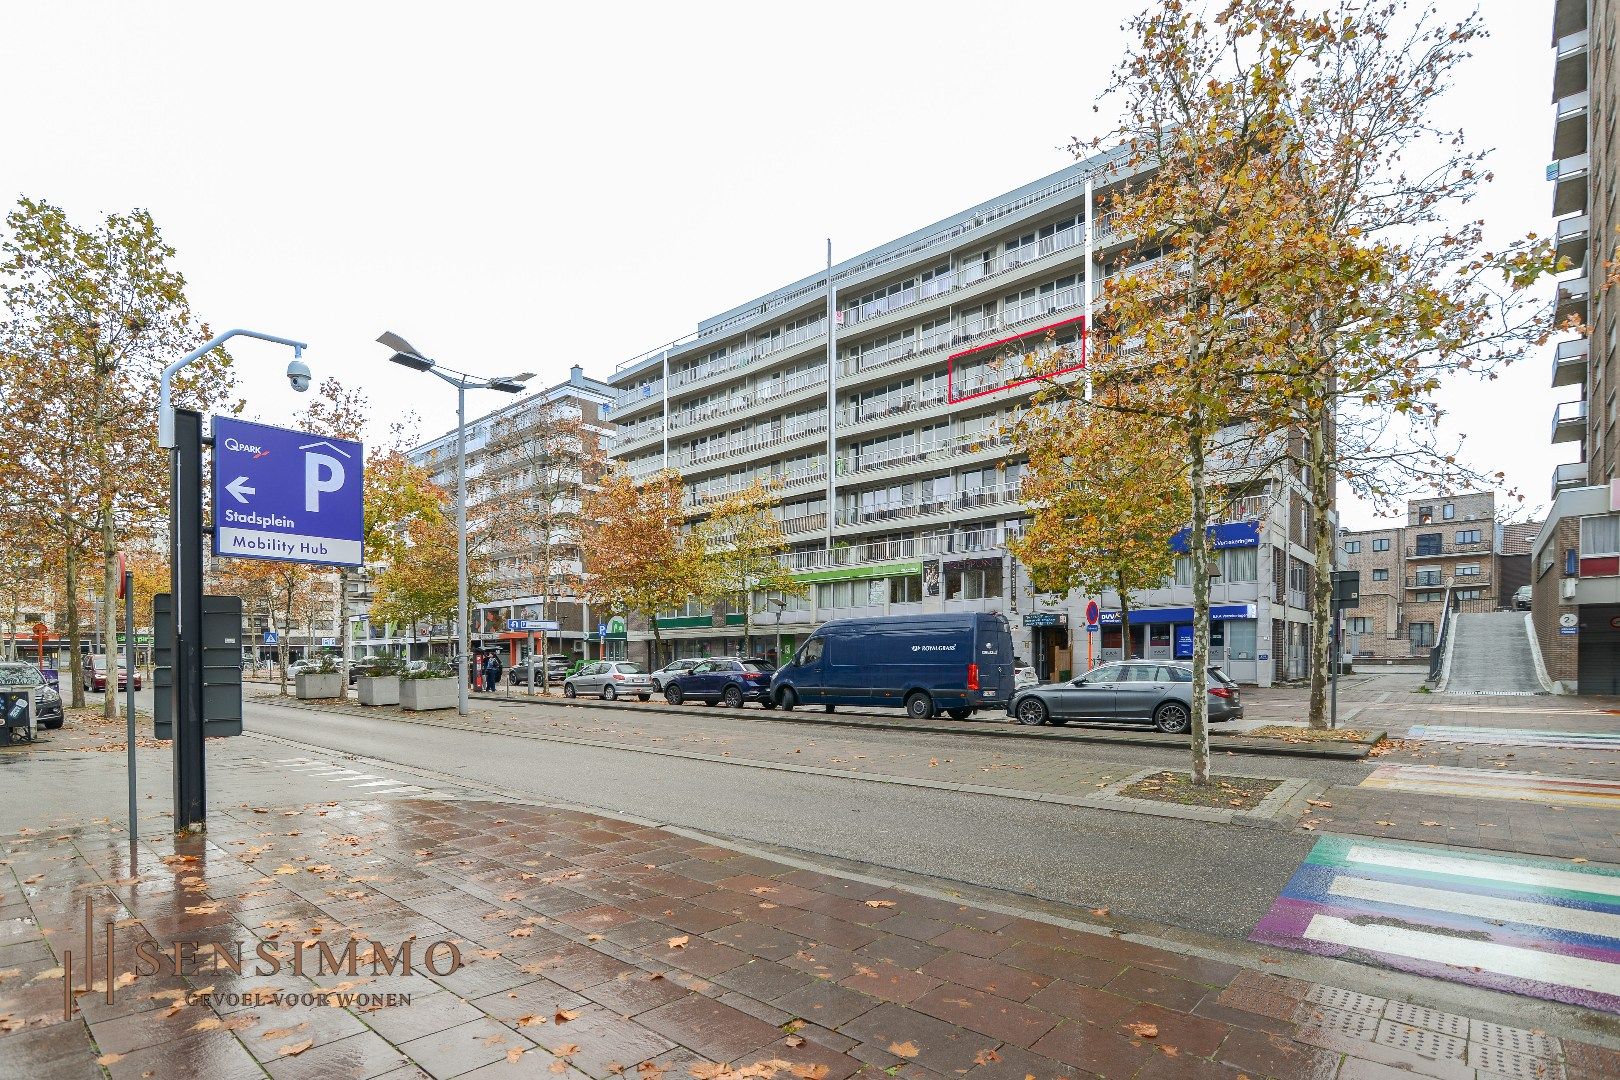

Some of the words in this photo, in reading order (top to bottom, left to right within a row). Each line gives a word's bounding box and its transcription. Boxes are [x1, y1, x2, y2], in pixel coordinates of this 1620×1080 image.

[305, 452, 345, 513] P
[225, 509, 295, 529] Stadsplein
[233, 536, 295, 555] Mobility
[300, 542, 328, 555] Hub
[599, 625, 606, 635] P
